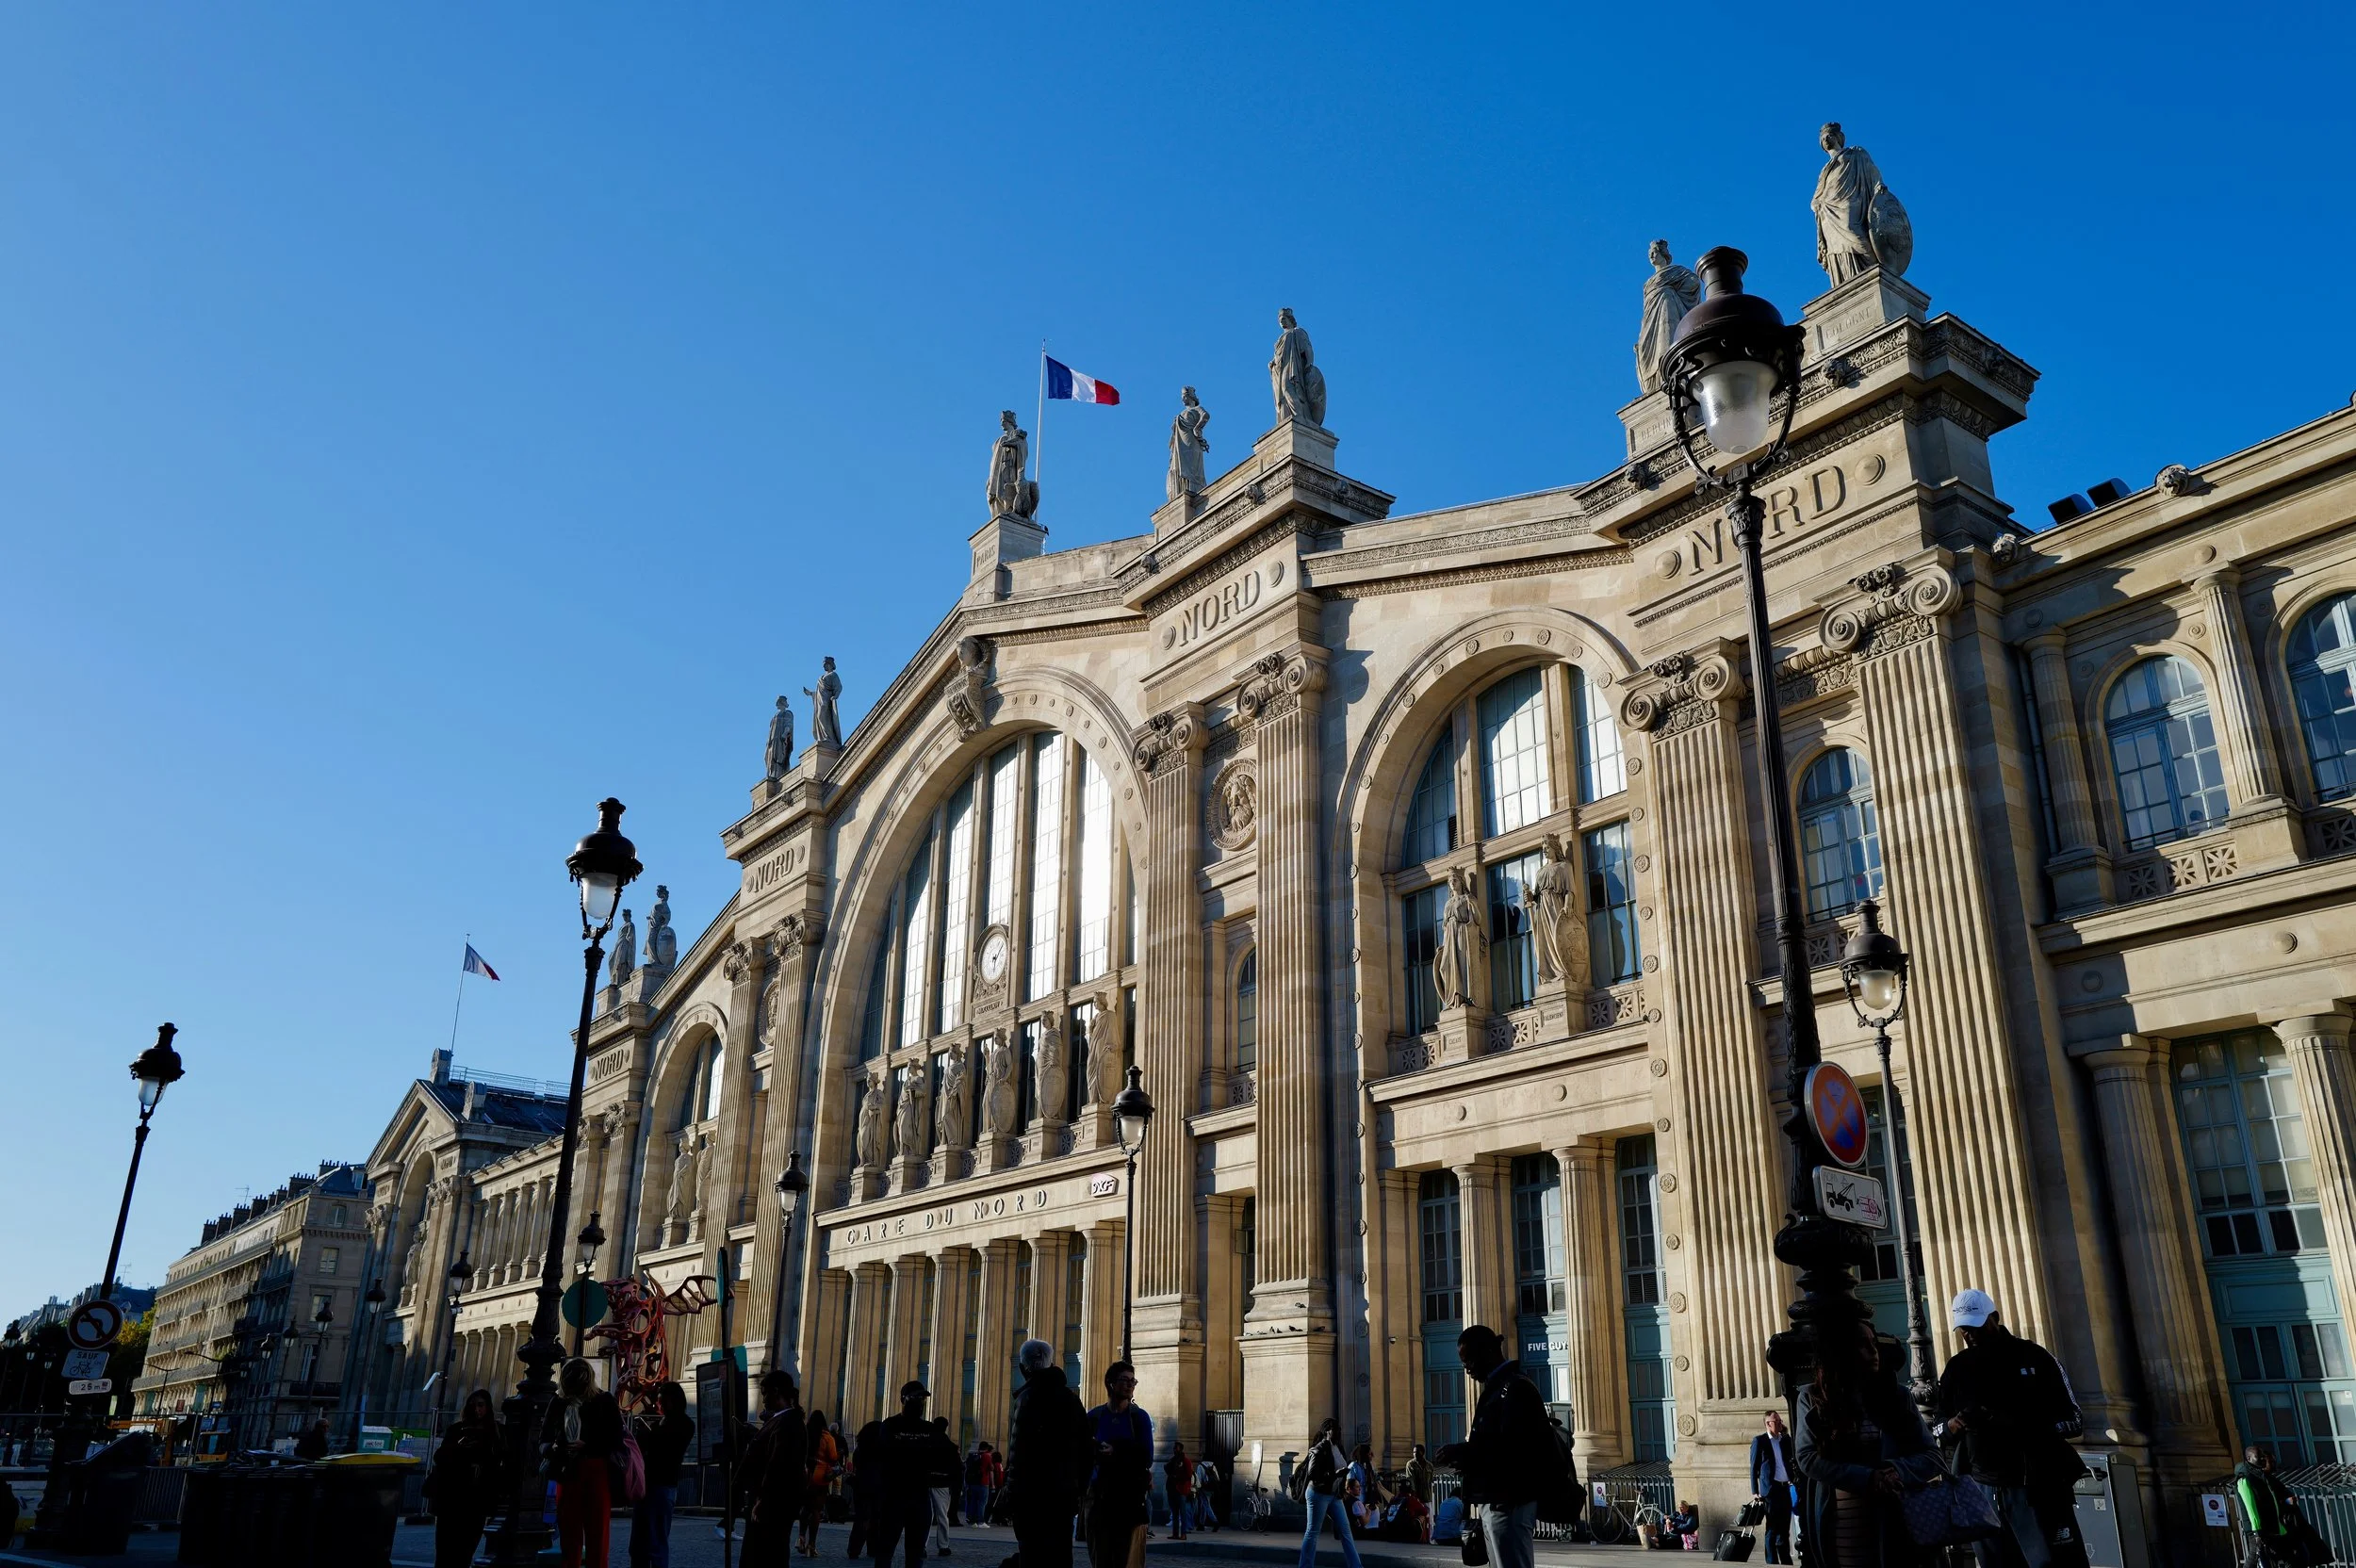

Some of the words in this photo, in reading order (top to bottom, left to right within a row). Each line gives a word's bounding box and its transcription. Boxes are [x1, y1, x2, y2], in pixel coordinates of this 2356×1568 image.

[1688, 465, 1846, 577] NRD
[976, 545, 995, 567] PARIS
[1178, 569, 1261, 647] NORD
[754, 847, 794, 893] NORD
[595, 1048, 624, 1082] NORD
[846, 1217, 906, 1246] GARE
[924, 1207, 953, 1230] DU
[973, 1188, 1048, 1219] NORD
[1528, 1342, 1547, 1351] FIVE
